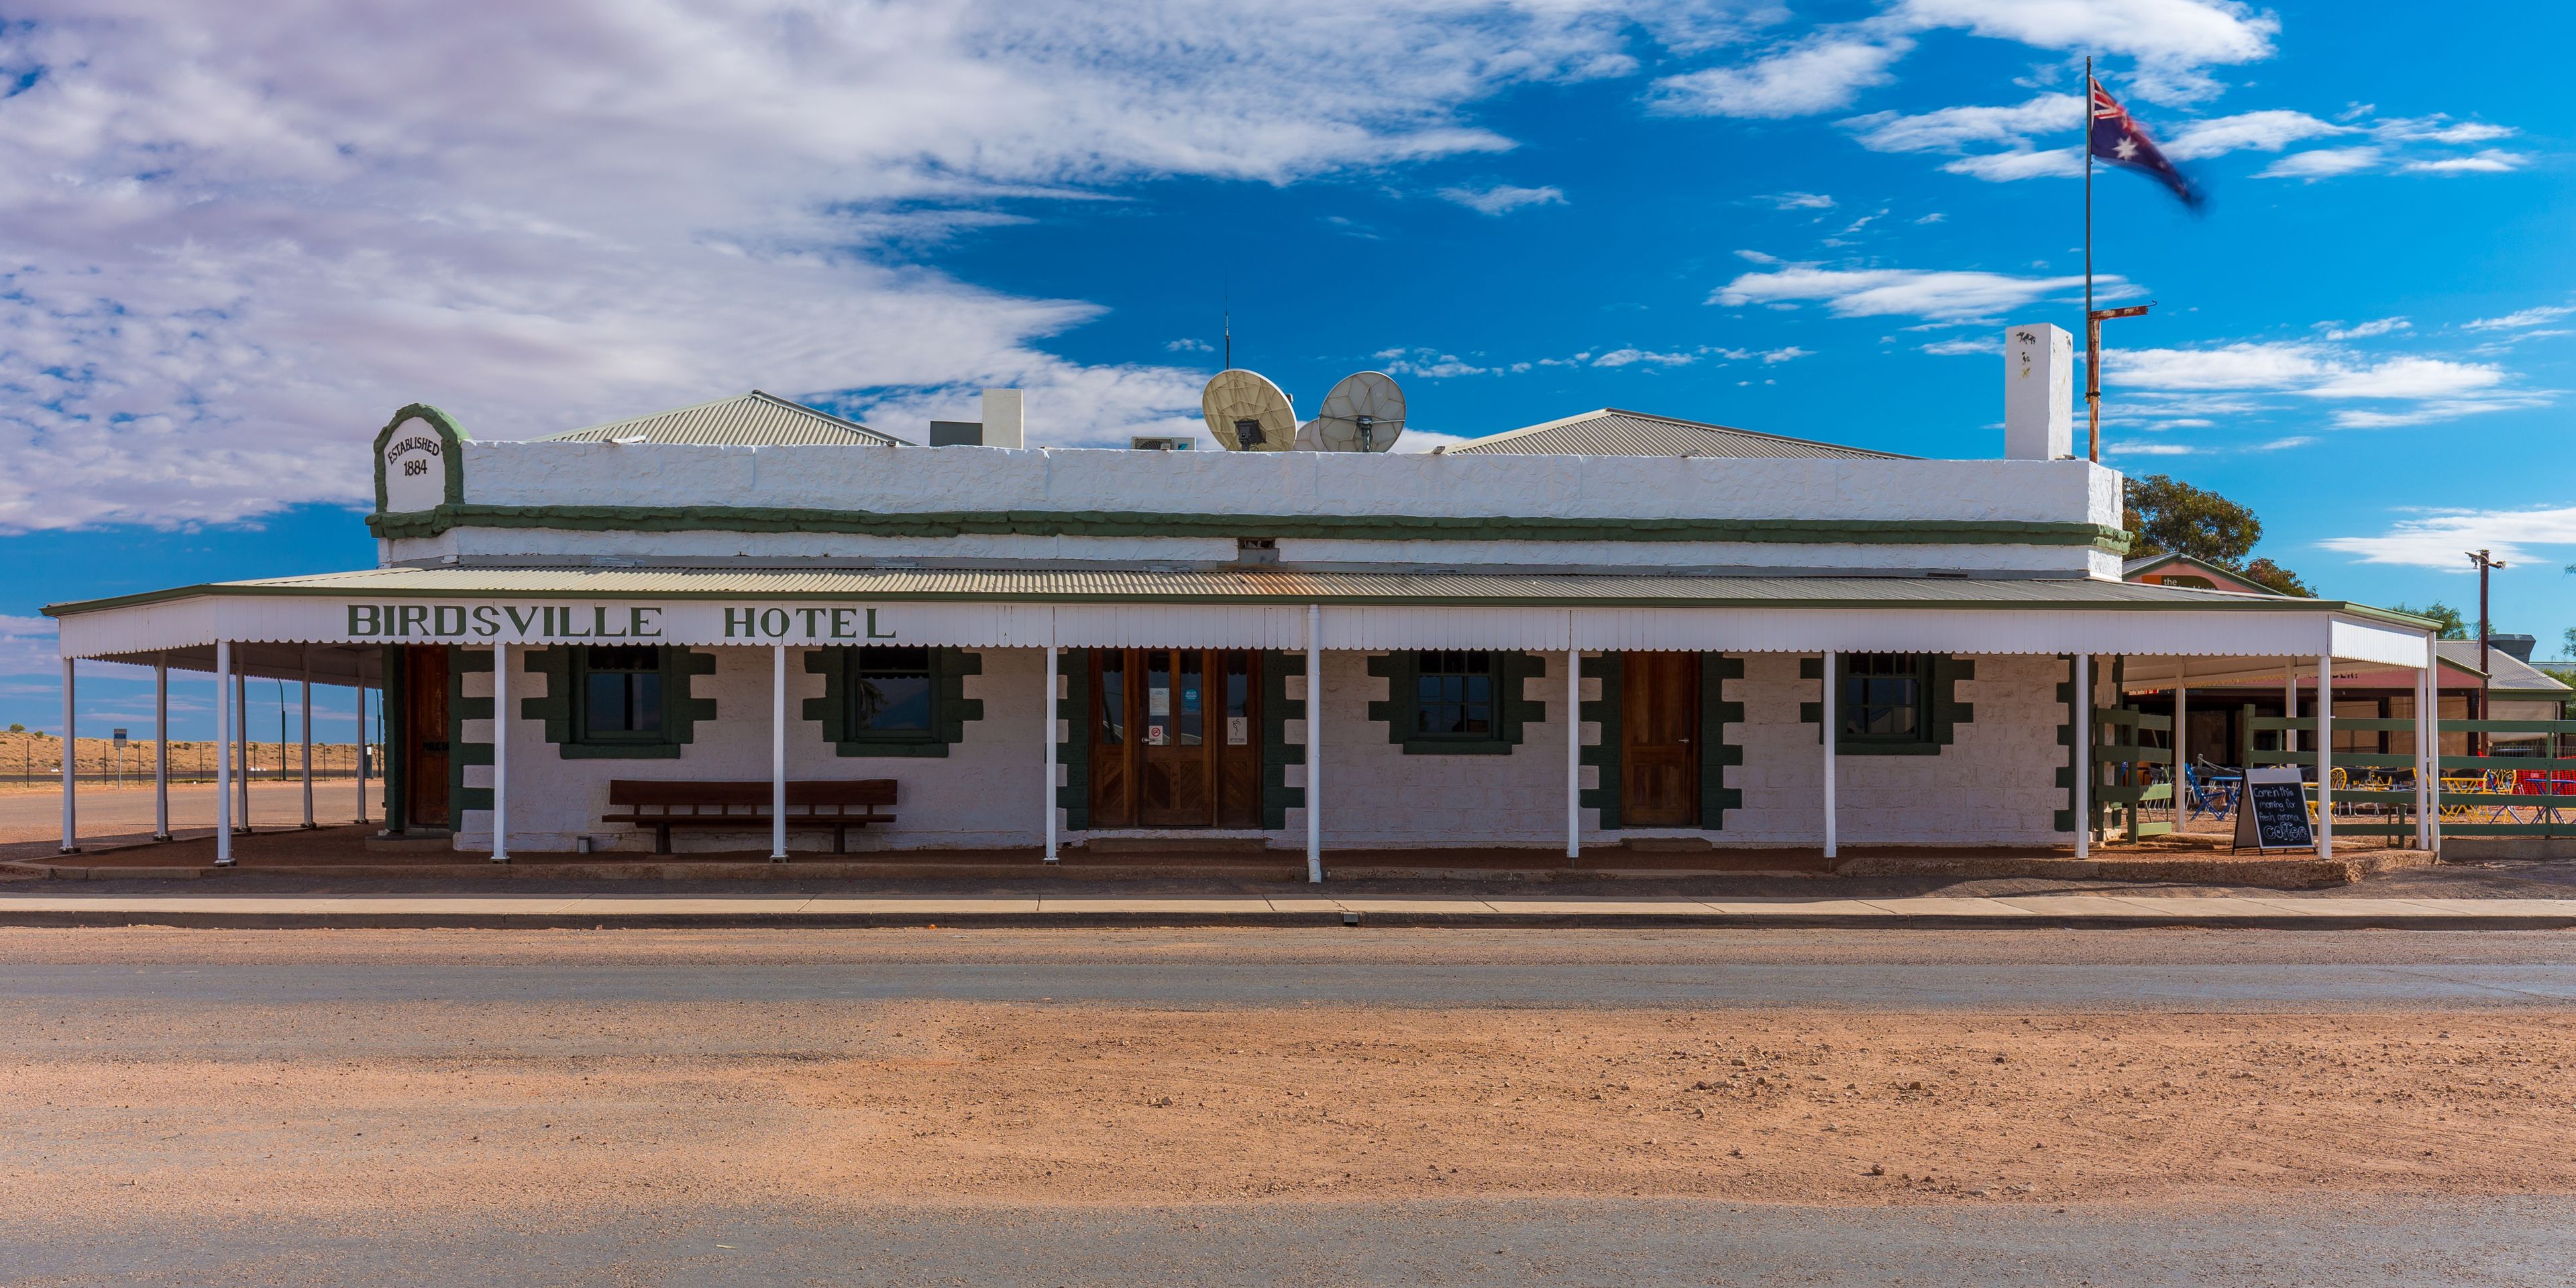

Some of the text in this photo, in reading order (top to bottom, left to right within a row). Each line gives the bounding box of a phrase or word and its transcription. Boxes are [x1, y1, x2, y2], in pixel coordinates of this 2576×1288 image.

[388, 437, 439, 466] ESTABLISHED
[404, 459, 427, 476] 1884
[2163, 578, 2178, 586] the
[347, 604, 896, 639] BIRDSVILLE HOTEL
[2279, 786, 2294, 797] this
[2259, 798, 2295, 811] morning for
[2259, 811, 2304, 822] fresh aroma
[2263, 821, 2308, 841] coffee
